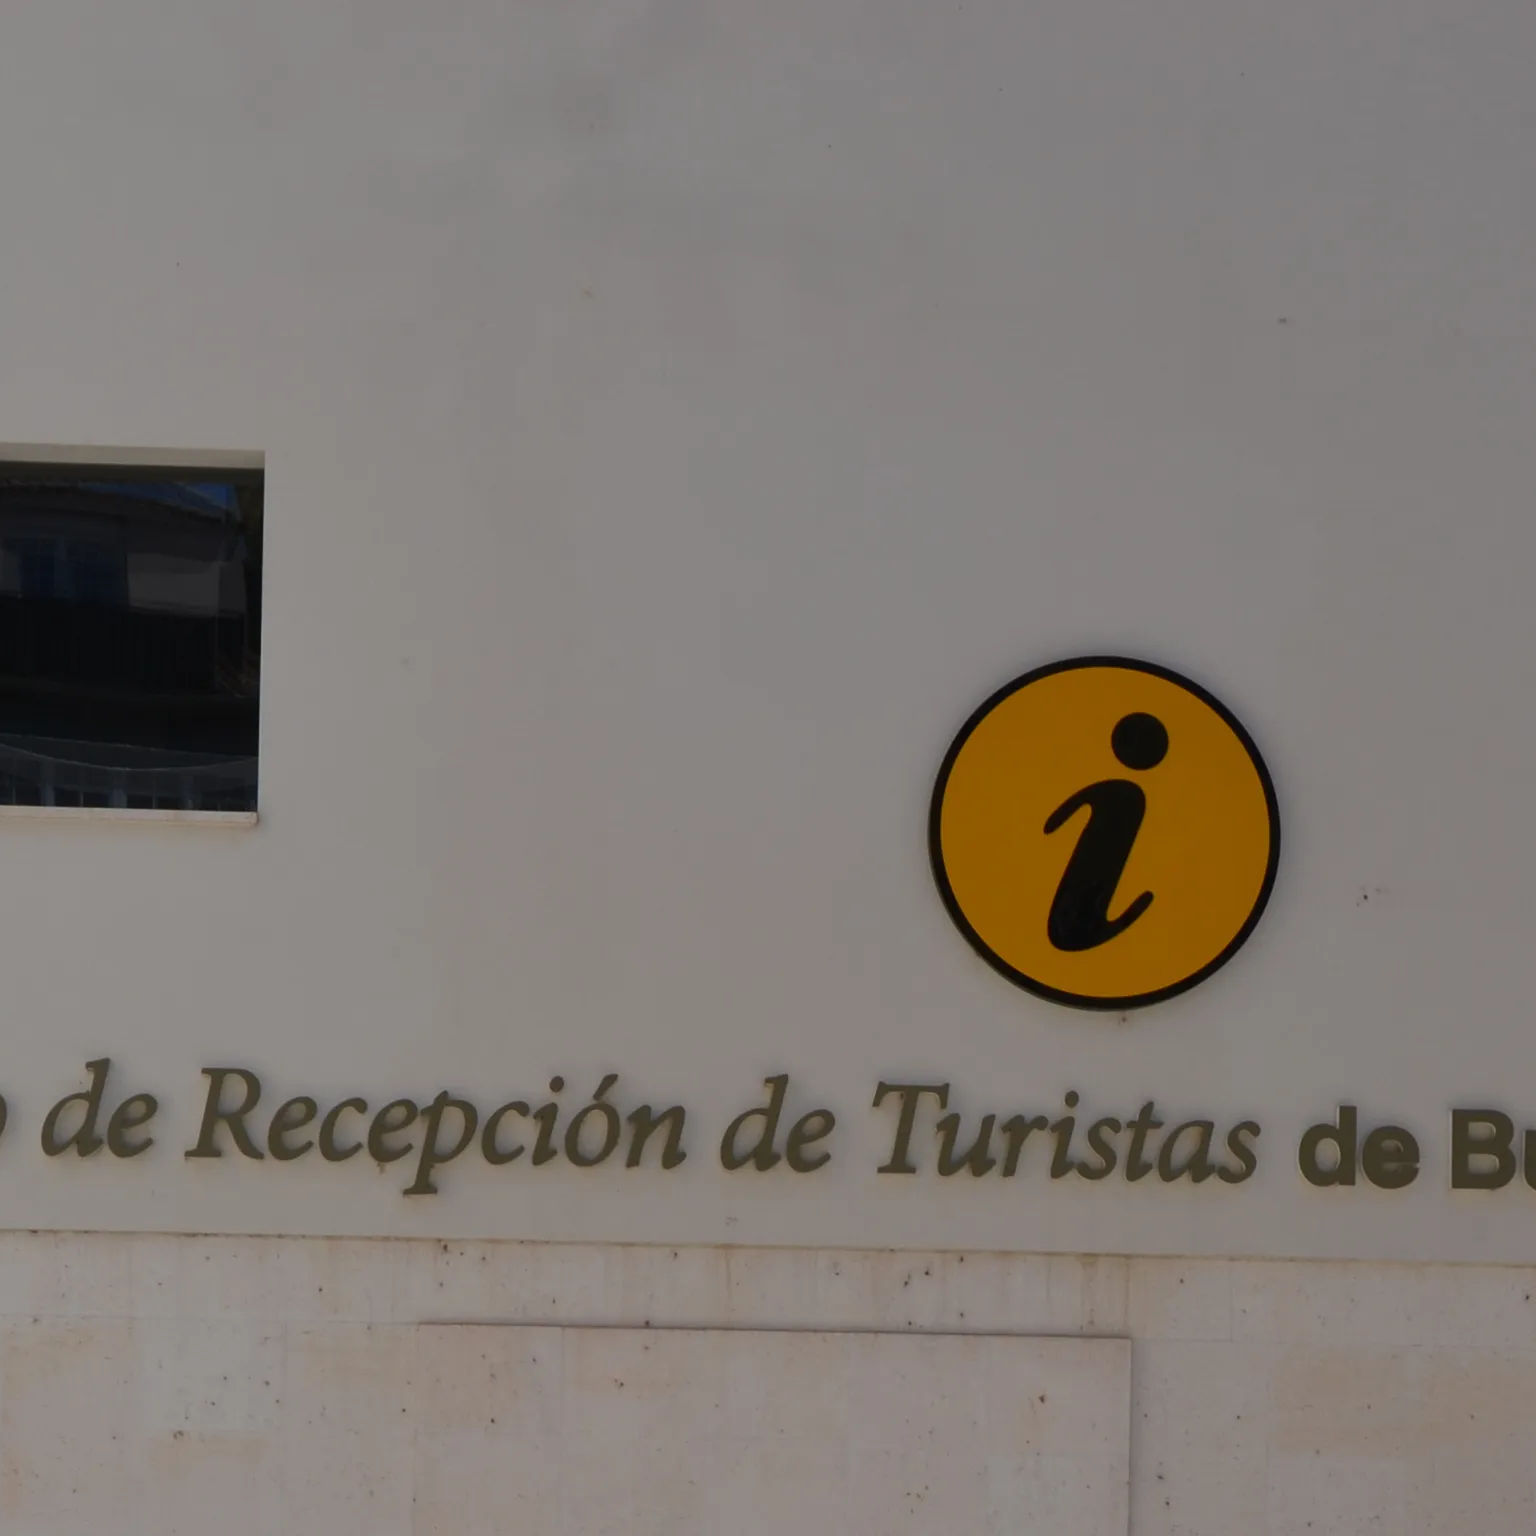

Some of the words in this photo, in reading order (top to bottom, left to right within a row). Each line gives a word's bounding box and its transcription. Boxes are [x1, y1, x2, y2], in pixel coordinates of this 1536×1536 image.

[40, 1057, 159, 1159] de
[183, 1067, 688, 1197] Recepción
[719, 1073, 836, 1174] de
[871, 1080, 1262, 1185] Turistas
[1298, 1104, 1421, 1190] de
